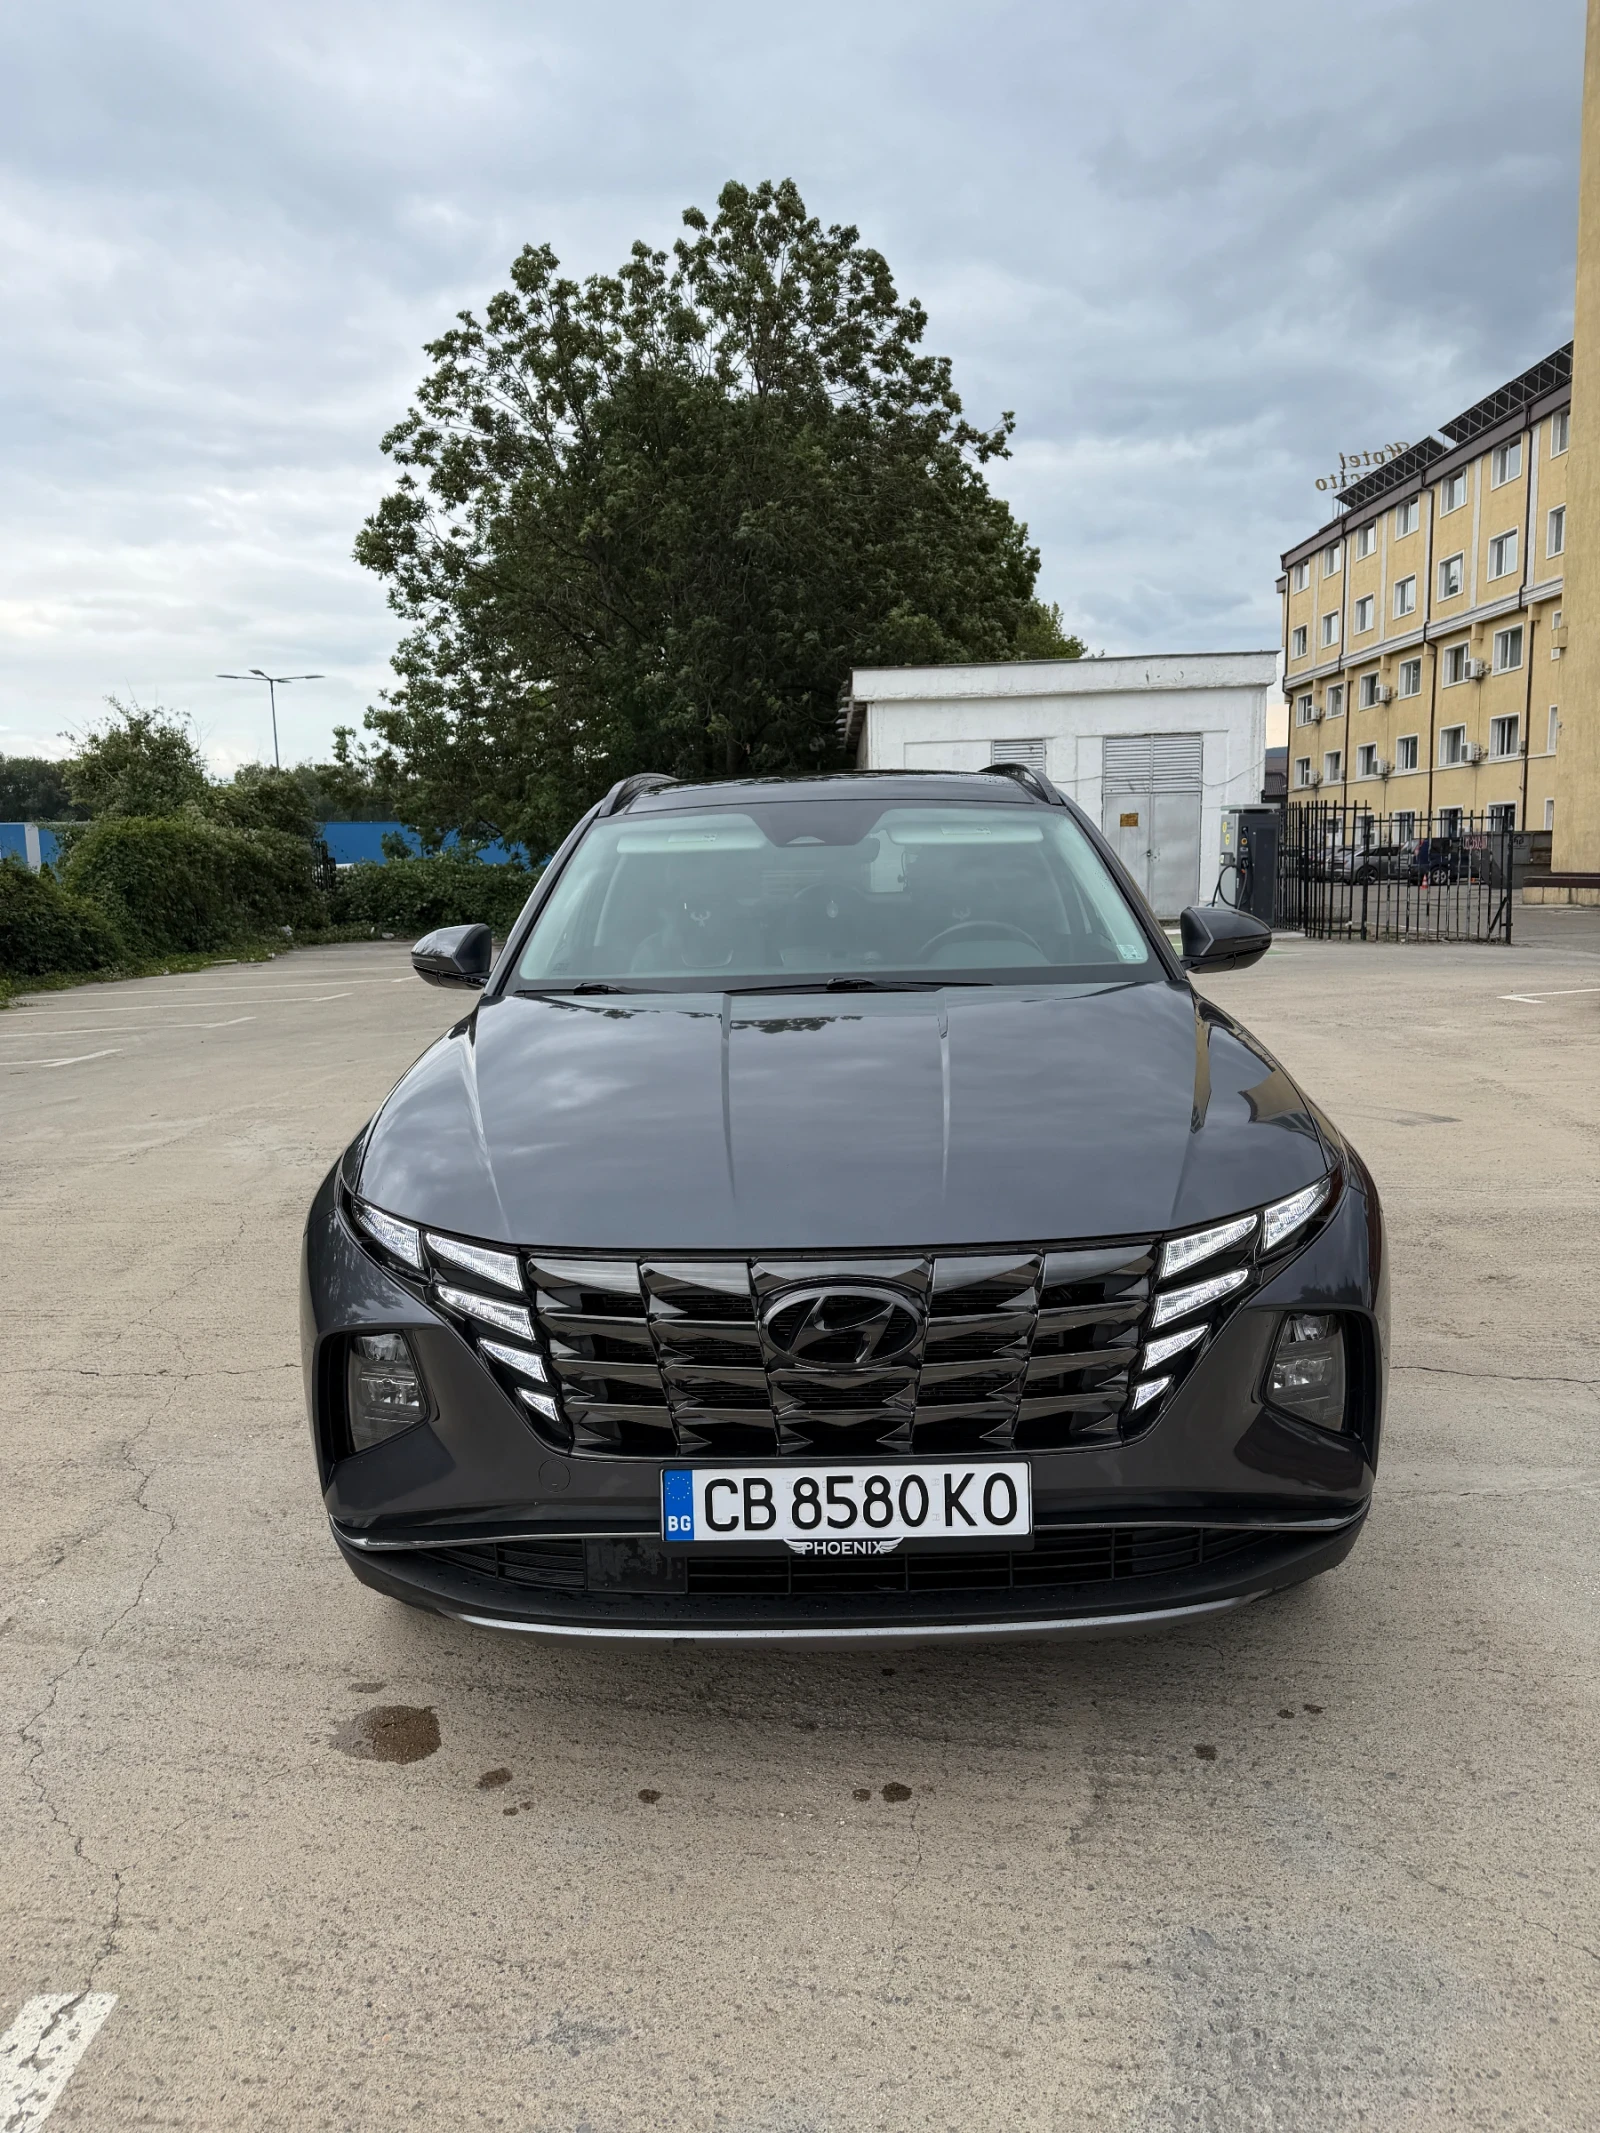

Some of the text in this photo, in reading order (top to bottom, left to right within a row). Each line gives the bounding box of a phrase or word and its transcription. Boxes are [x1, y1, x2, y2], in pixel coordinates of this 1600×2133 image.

[704, 1472, 1018, 1532] CB 8580 KO
[667, 1515, 692, 1532] BG
[801, 1540, 885, 1555] PHOENIX
